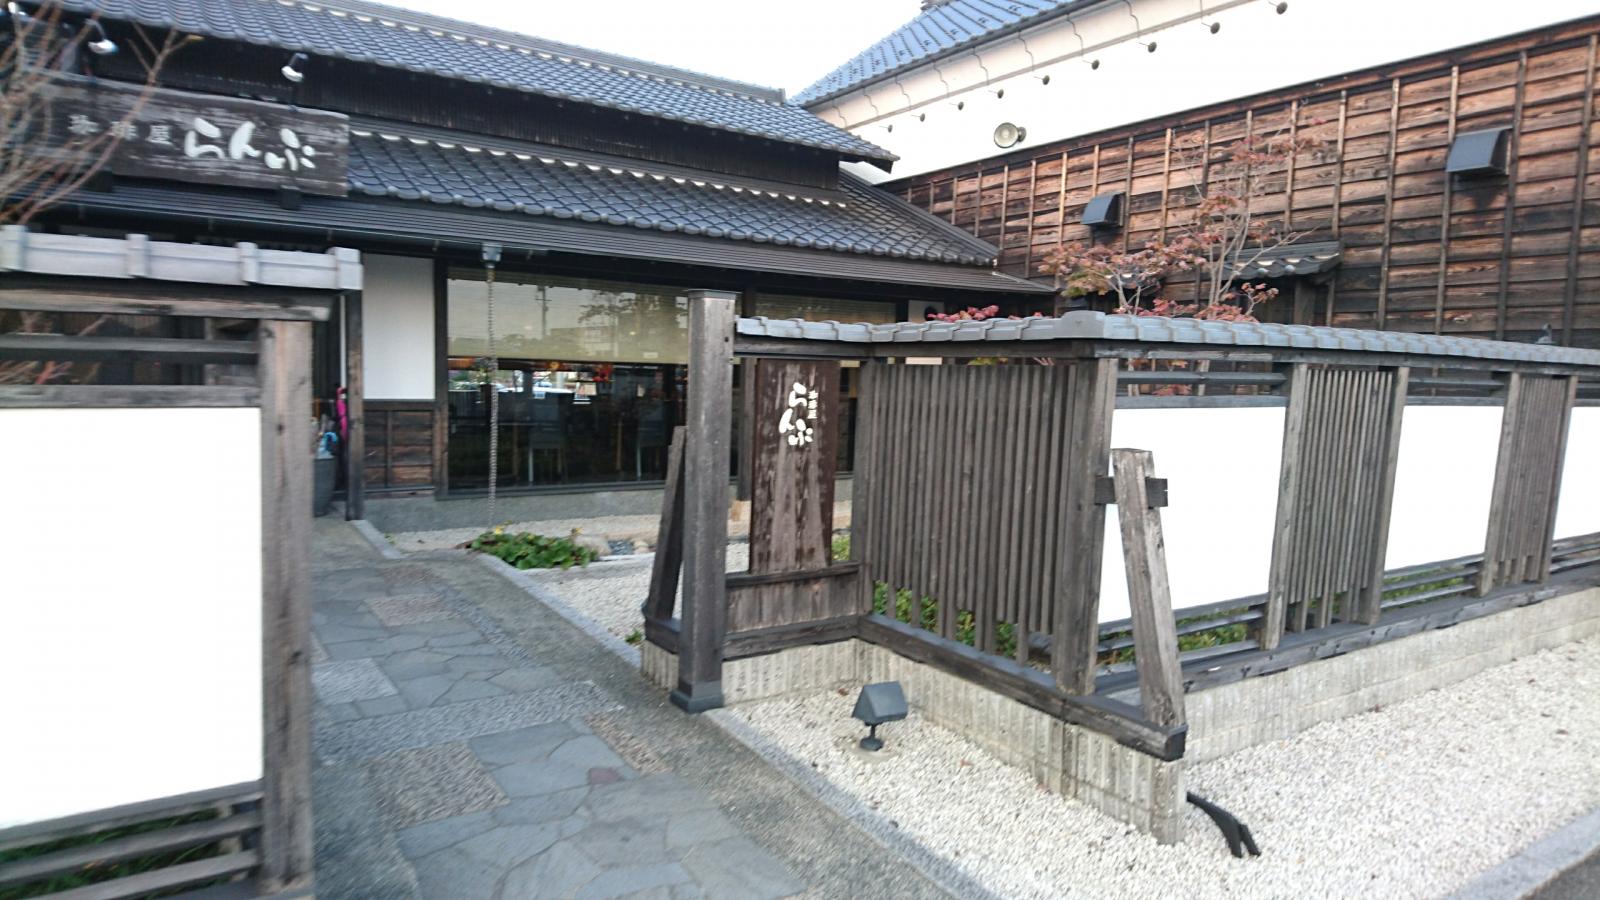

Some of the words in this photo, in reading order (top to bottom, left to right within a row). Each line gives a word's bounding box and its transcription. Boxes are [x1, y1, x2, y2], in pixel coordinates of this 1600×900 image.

[184, 117, 315, 171] らんぷ
[779, 382, 813, 446] らんぷ
